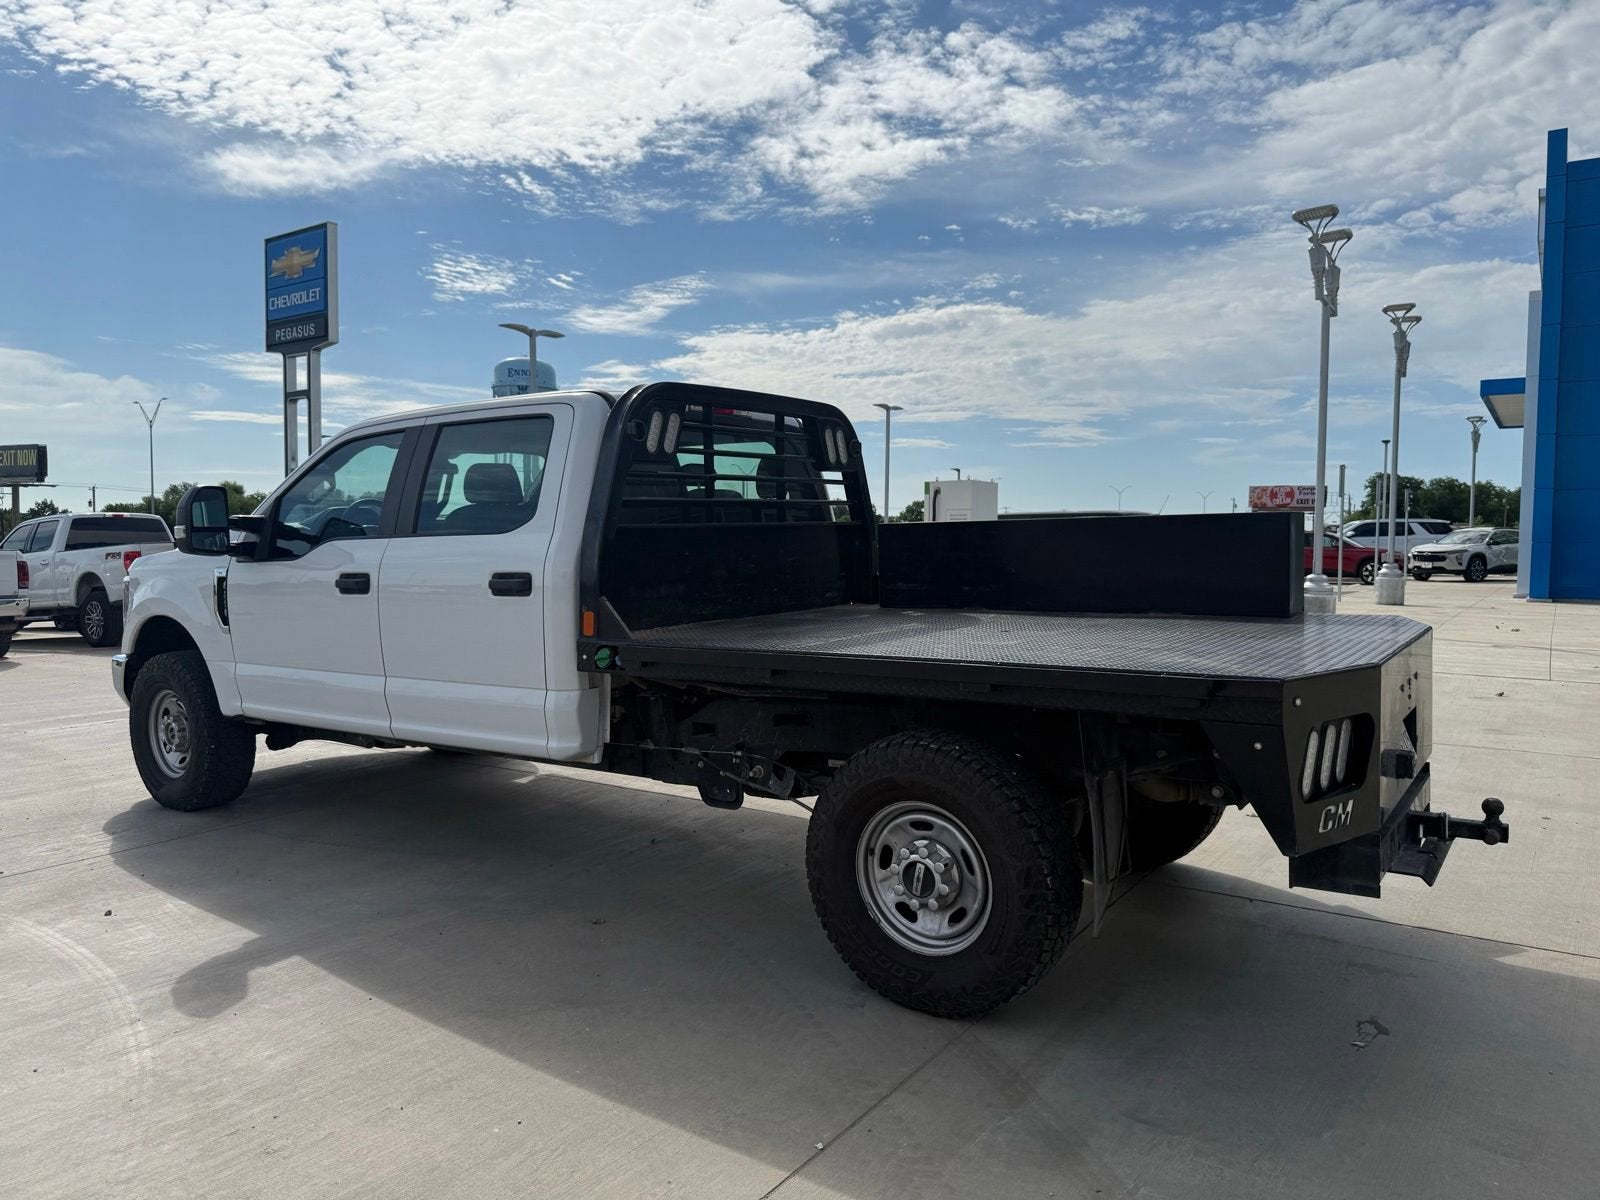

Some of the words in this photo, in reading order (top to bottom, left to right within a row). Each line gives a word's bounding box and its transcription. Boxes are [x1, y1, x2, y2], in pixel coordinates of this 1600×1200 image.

[269, 287, 321, 310] CHEVROLET
[275, 323, 316, 341] PEGASUS
[17, 449, 38, 466] NOW
[1319, 799, 1354, 833] CM
